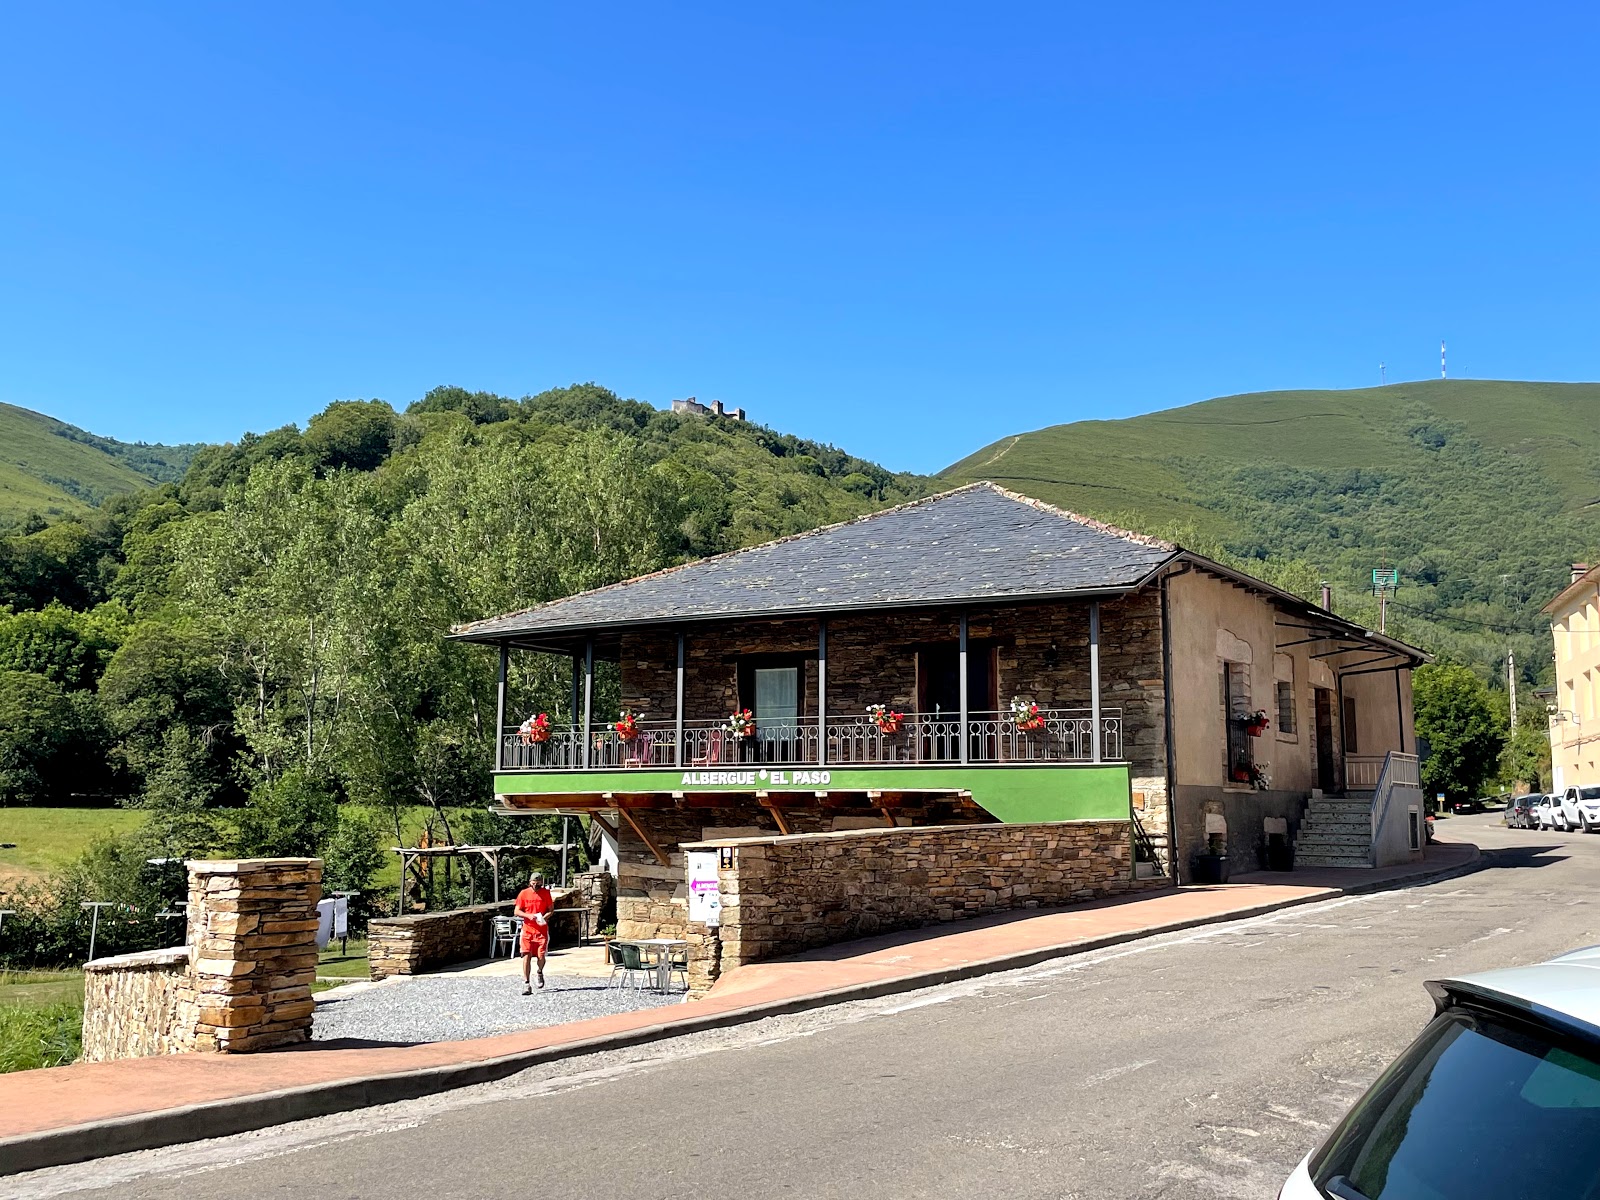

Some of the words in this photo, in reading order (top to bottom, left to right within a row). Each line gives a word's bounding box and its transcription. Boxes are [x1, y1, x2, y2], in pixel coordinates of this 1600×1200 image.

[681, 771, 755, 785] ALBERGUE
[770, 771, 789, 784] EL
[793, 770, 831, 784] PASO
